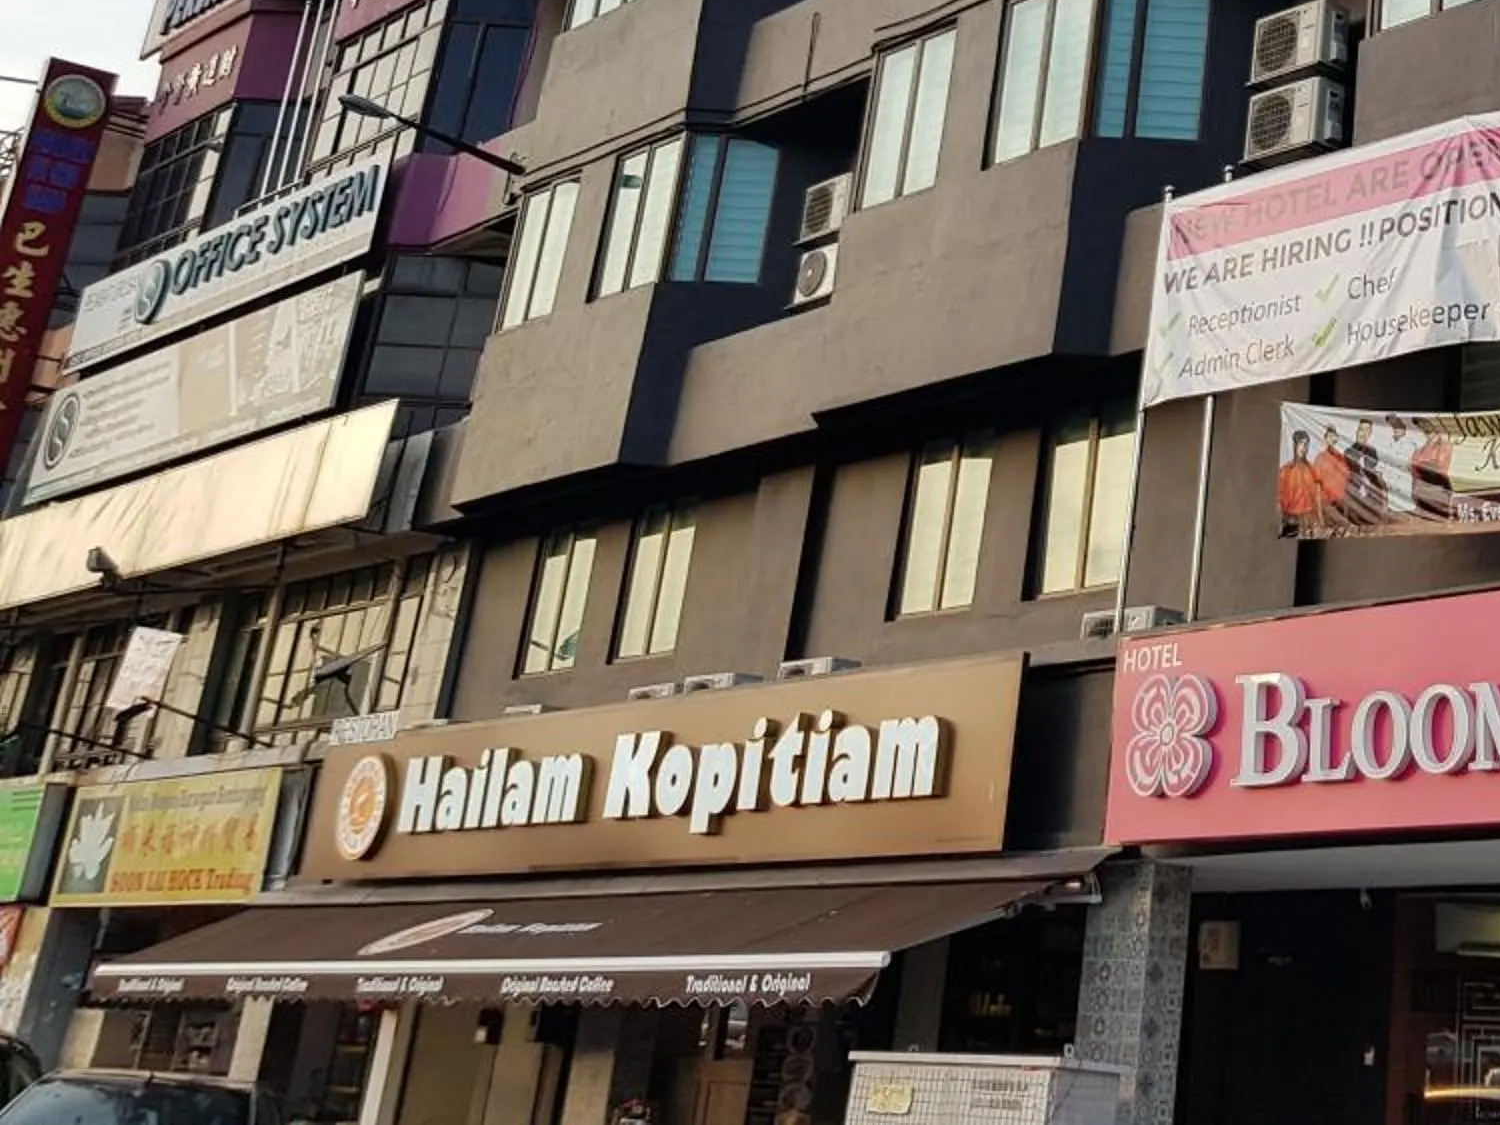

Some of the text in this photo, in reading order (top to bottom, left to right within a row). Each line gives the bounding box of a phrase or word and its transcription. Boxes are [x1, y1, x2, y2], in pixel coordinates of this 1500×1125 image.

[1248, 183, 1339, 227] HOTEL
[1346, 164, 1409, 200] ARE
[172, 215, 269, 296] OFFICE
[268, 164, 381, 255] SYSTEM
[1163, 263, 1199, 295] WE
[1203, 252, 1254, 285] ARE
[1260, 228, 1352, 273] HIRING
[1187, 266, 1399, 335] Receptionist Chef
[1178, 299, 1491, 378] Admin Clerk Housekeeper
[1123, 642, 1183, 674] HOTEL
[398, 746, 593, 835] Hailam
[603, 708, 950, 836] Kopitiam
[686, 974, 747, 994] Traditional
[760, 971, 811, 996] Original
